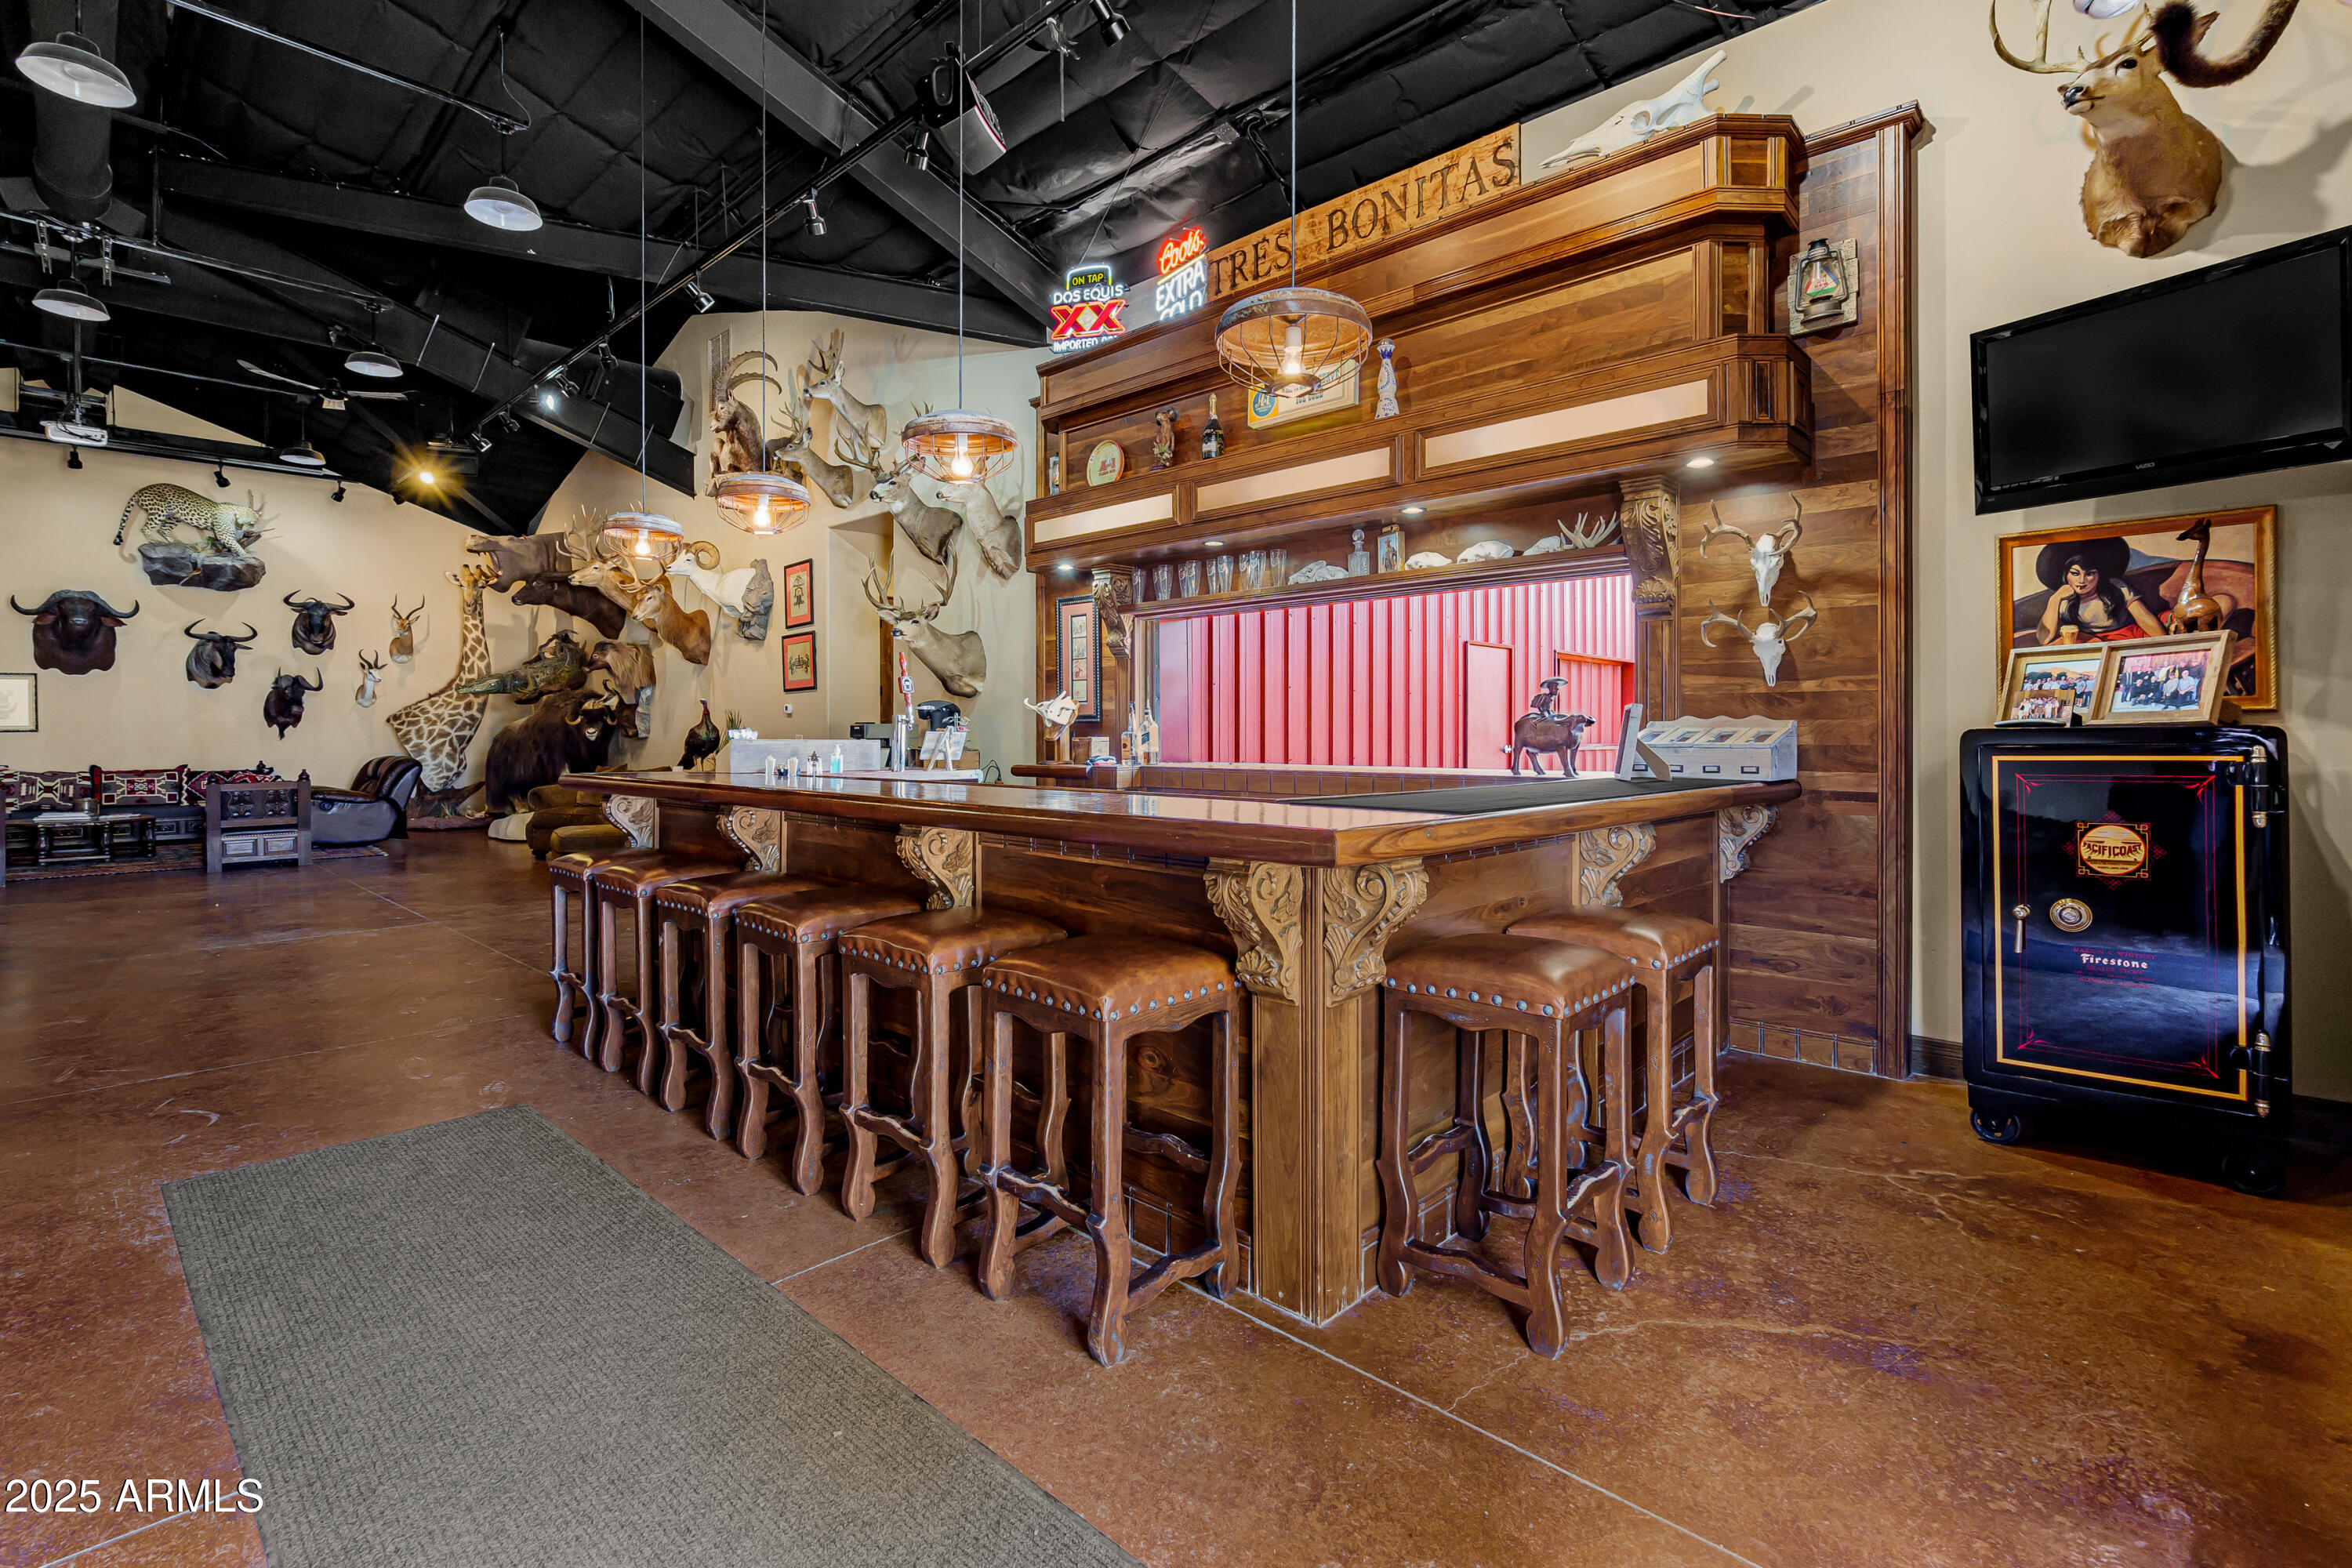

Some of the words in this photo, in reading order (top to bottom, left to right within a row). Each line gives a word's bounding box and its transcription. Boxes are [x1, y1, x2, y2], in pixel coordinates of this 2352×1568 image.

[1208, 232, 1292, 296] TRES
[1326, 142, 1519, 251] BONITAS
[1072, 275, 1085, 286] ON
[1087, 273, 1104, 284] TAP
[1156, 260, 1206, 312] EXTRA
[1053, 289, 1081, 305] DOS
[1083, 284, 1124, 302] EQUIS
[1051, 299, 1127, 340] XX
[1054, 337, 1098, 352] IMPORTED
[2082, 841, 2142, 857] PACIFICOAST
[2080, 953, 2148, 969] Firestone
